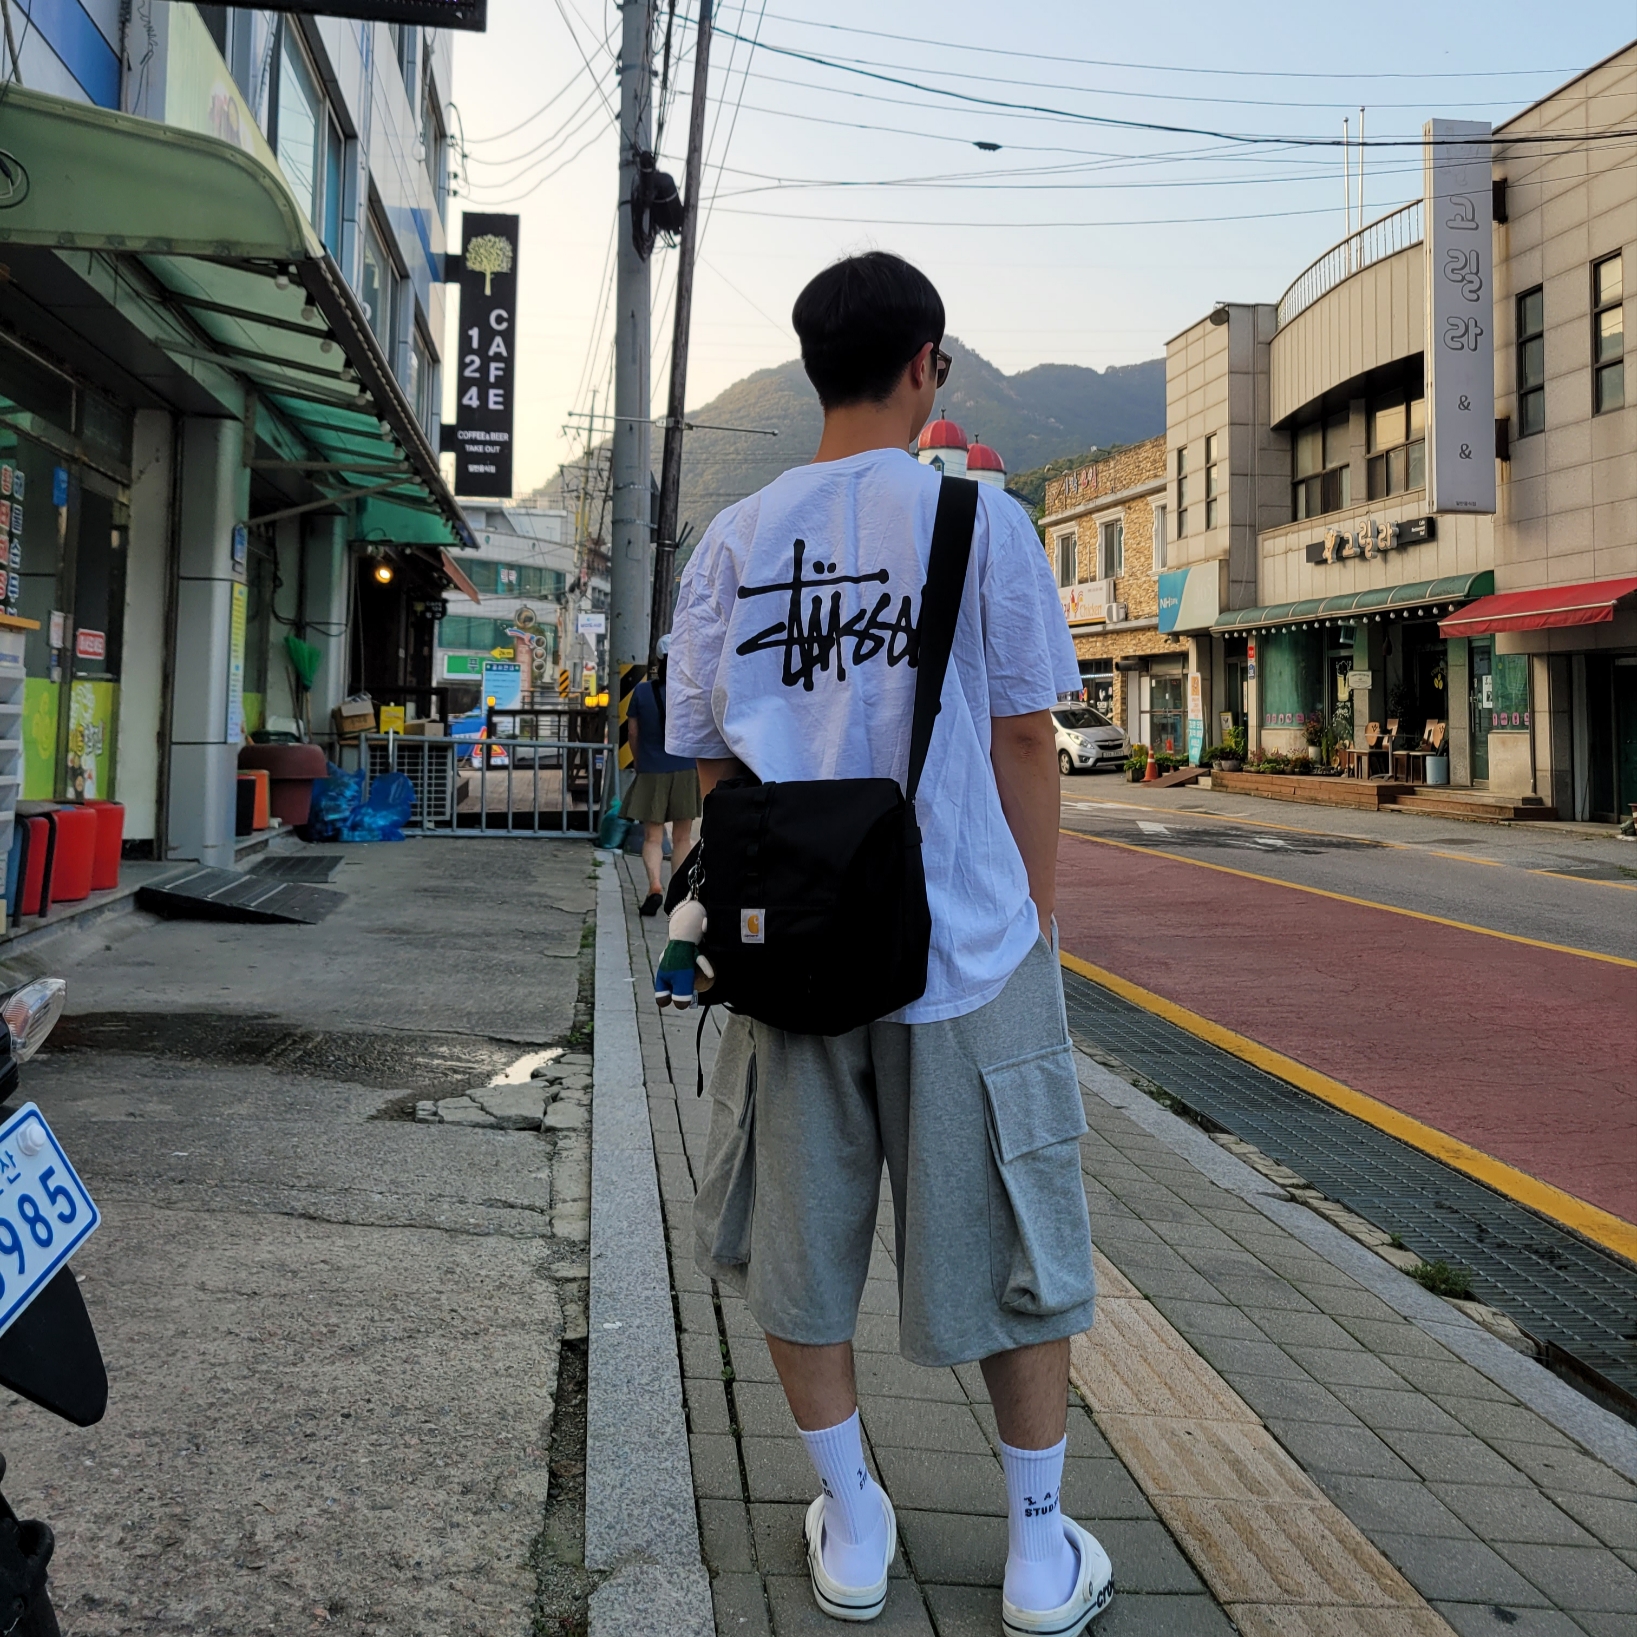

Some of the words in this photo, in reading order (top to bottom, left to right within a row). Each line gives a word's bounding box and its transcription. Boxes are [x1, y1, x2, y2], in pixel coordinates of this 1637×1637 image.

[1443, 195, 1484, 351] 고릴라
[461, 326, 481, 409] 124
[488, 308, 509, 410] CAFE
[465, 444, 484, 453] TAKE
[485, 445, 501, 453] OUT
[1342, 518, 1400, 560] 고릴라
[1080, 603, 1103, 618] Chicken
[0, 1165, 77, 1301] 985
